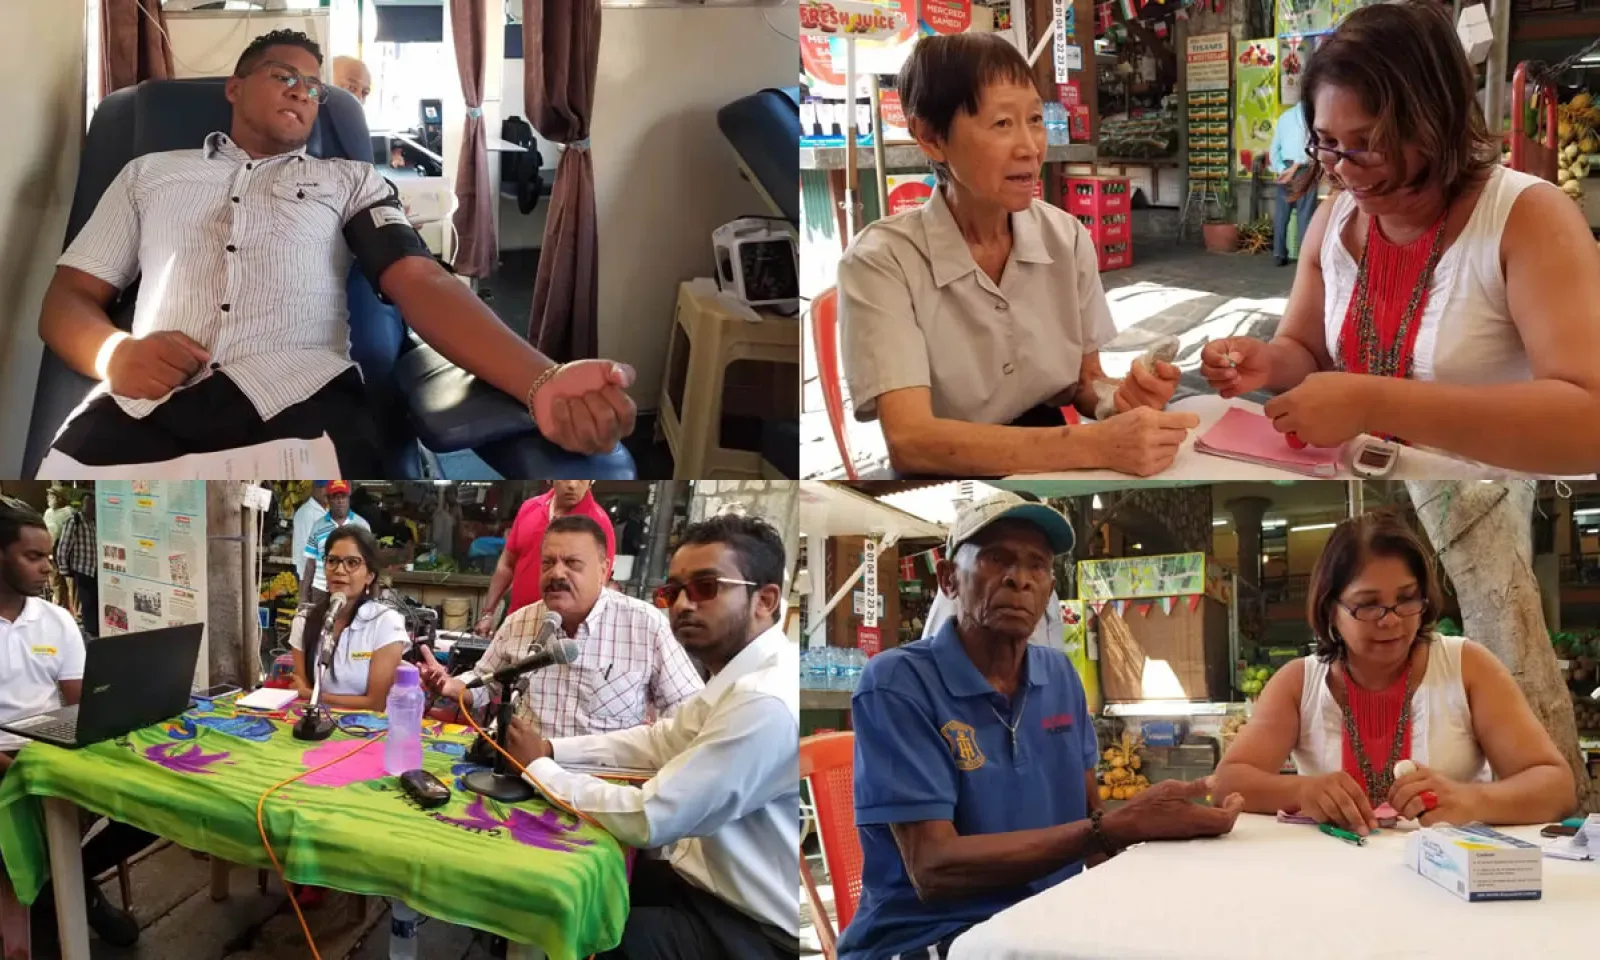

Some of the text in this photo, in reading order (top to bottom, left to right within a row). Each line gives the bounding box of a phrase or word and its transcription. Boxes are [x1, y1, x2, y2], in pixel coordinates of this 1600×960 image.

[927, 4, 966, 19] MERCREDI
[800, 7, 849, 25] FRESH
[854, 12, 895, 30] JUICE
[932, 15, 962, 29] SAMEDI
[867, 553, 875, 562] 01
[867, 587, 875, 597] 22
[867, 599, 875, 609] 23
